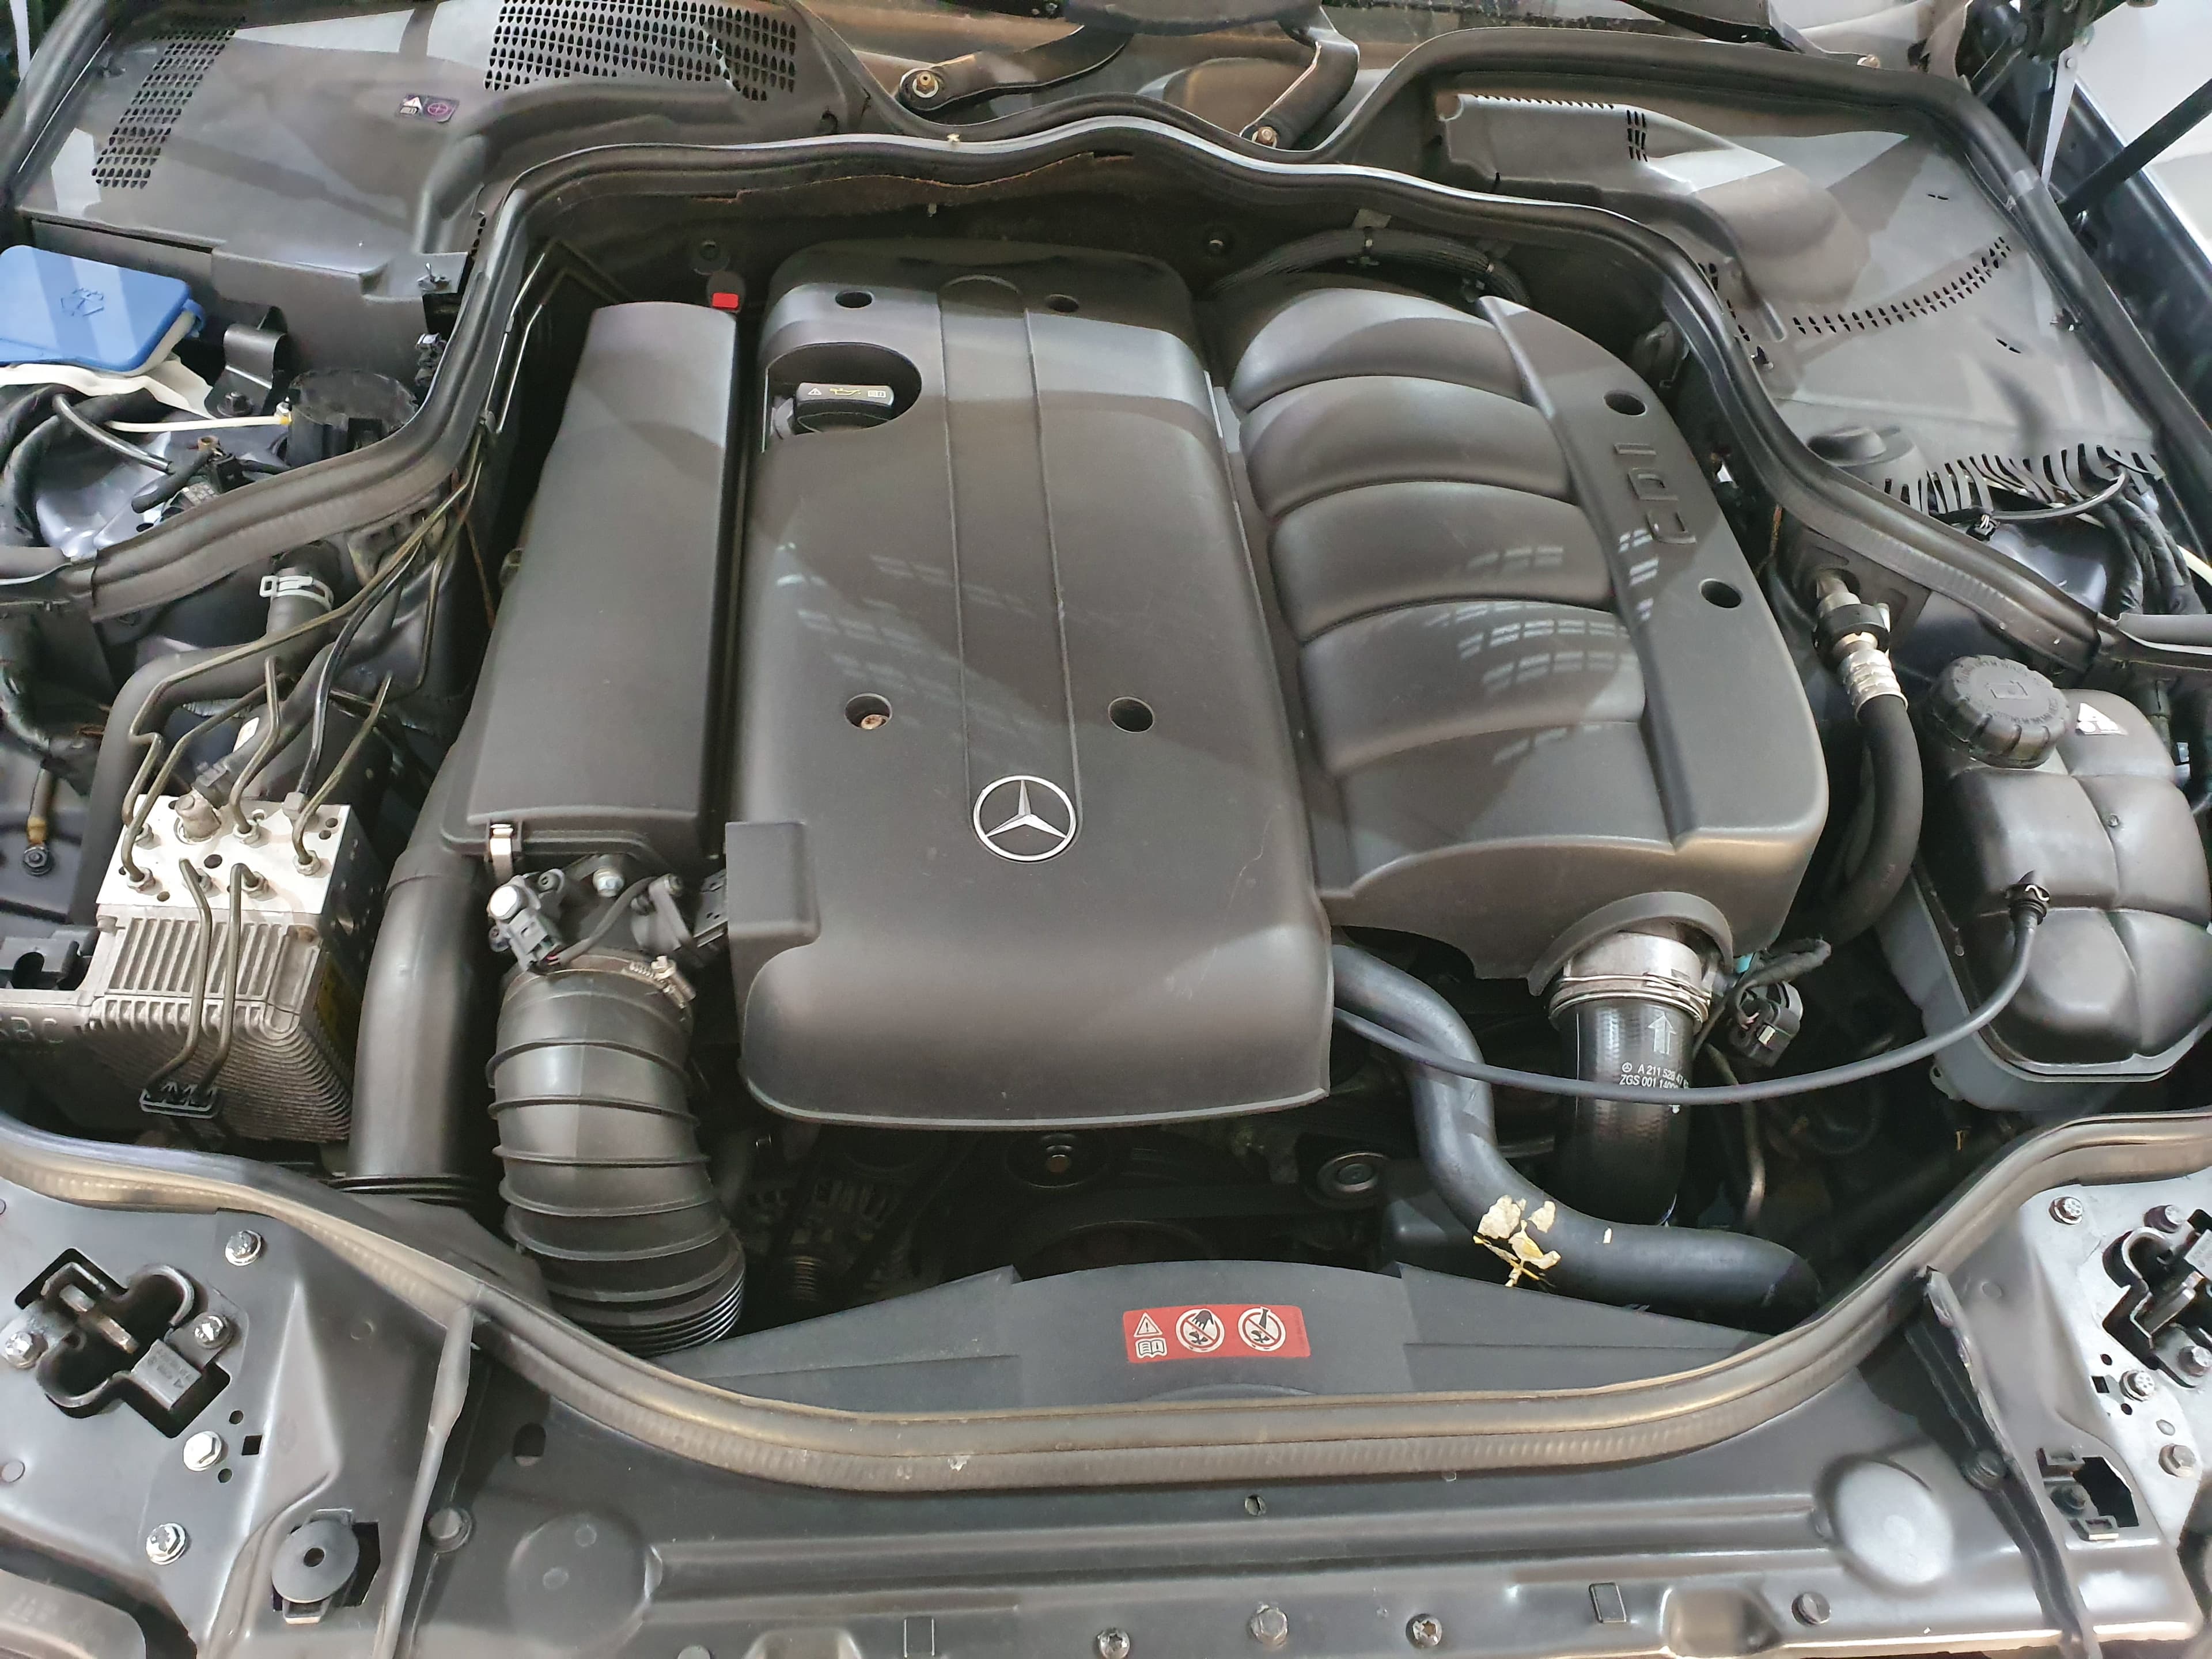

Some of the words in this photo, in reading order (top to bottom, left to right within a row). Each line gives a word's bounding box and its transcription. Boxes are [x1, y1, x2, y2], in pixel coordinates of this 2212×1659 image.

[1613, 442, 1697, 545] CDI
[1637, 1063, 1645, 1074] A
[1646, 1065, 1661, 1077] 211
[1619, 1074, 1641, 1086] ZGS
[1642, 1076, 1656, 1088] 001
